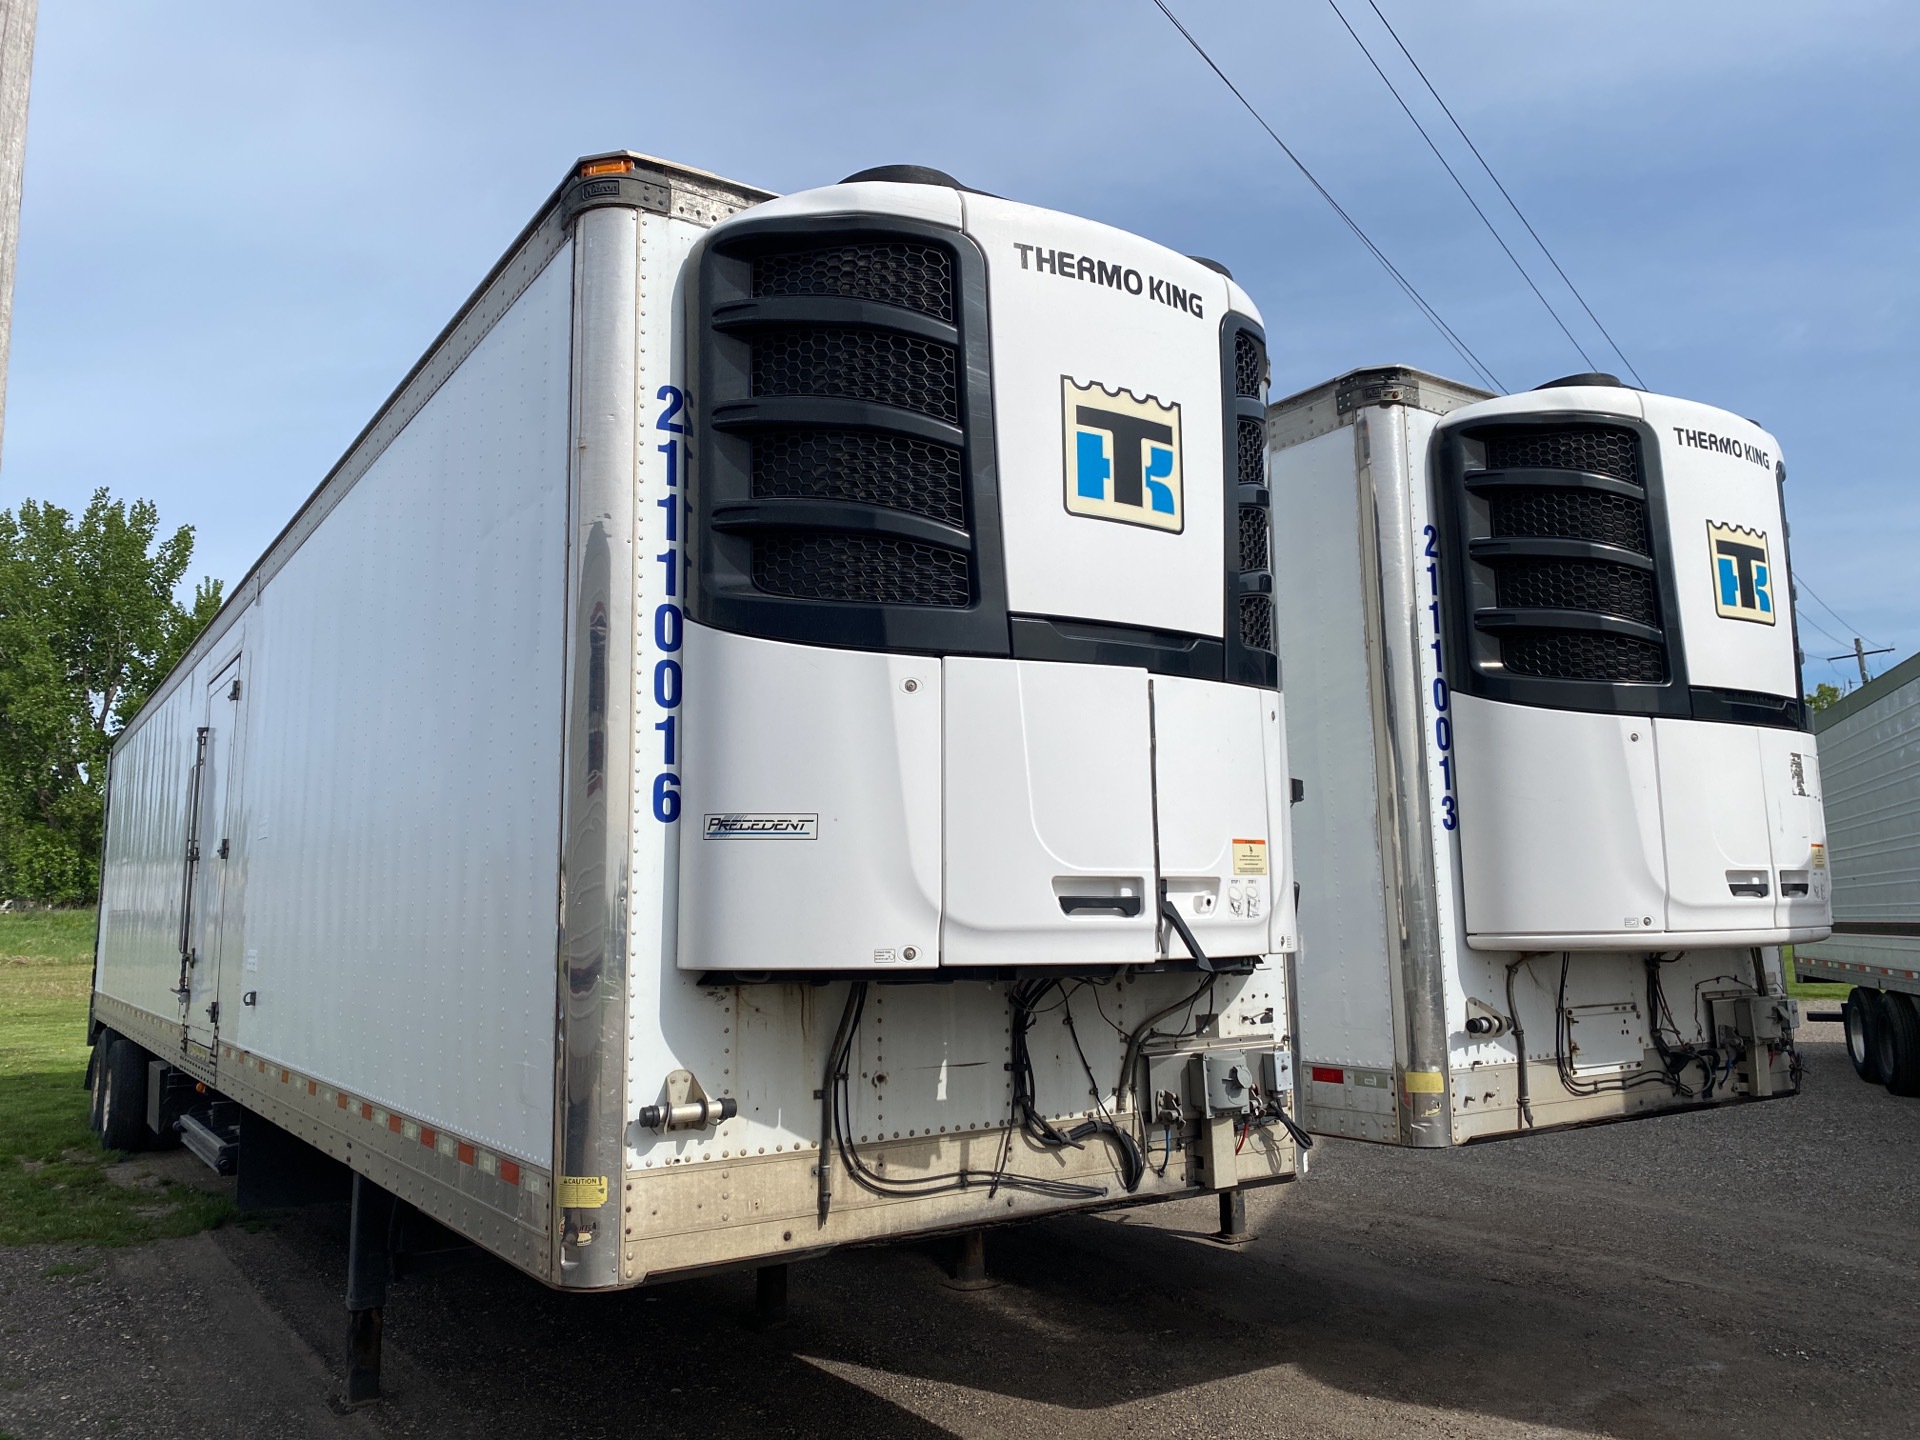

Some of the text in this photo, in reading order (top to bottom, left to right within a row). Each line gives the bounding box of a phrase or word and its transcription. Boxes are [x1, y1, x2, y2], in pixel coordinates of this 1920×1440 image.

[1013, 242, 1203, 319] THERMO KING
[1673, 427, 1770, 470] THERMO KING
[652, 385, 684, 824] 21110016
[1423, 524, 1457, 831] 21110013
[707, 818, 814, 831] PRECEDENT
